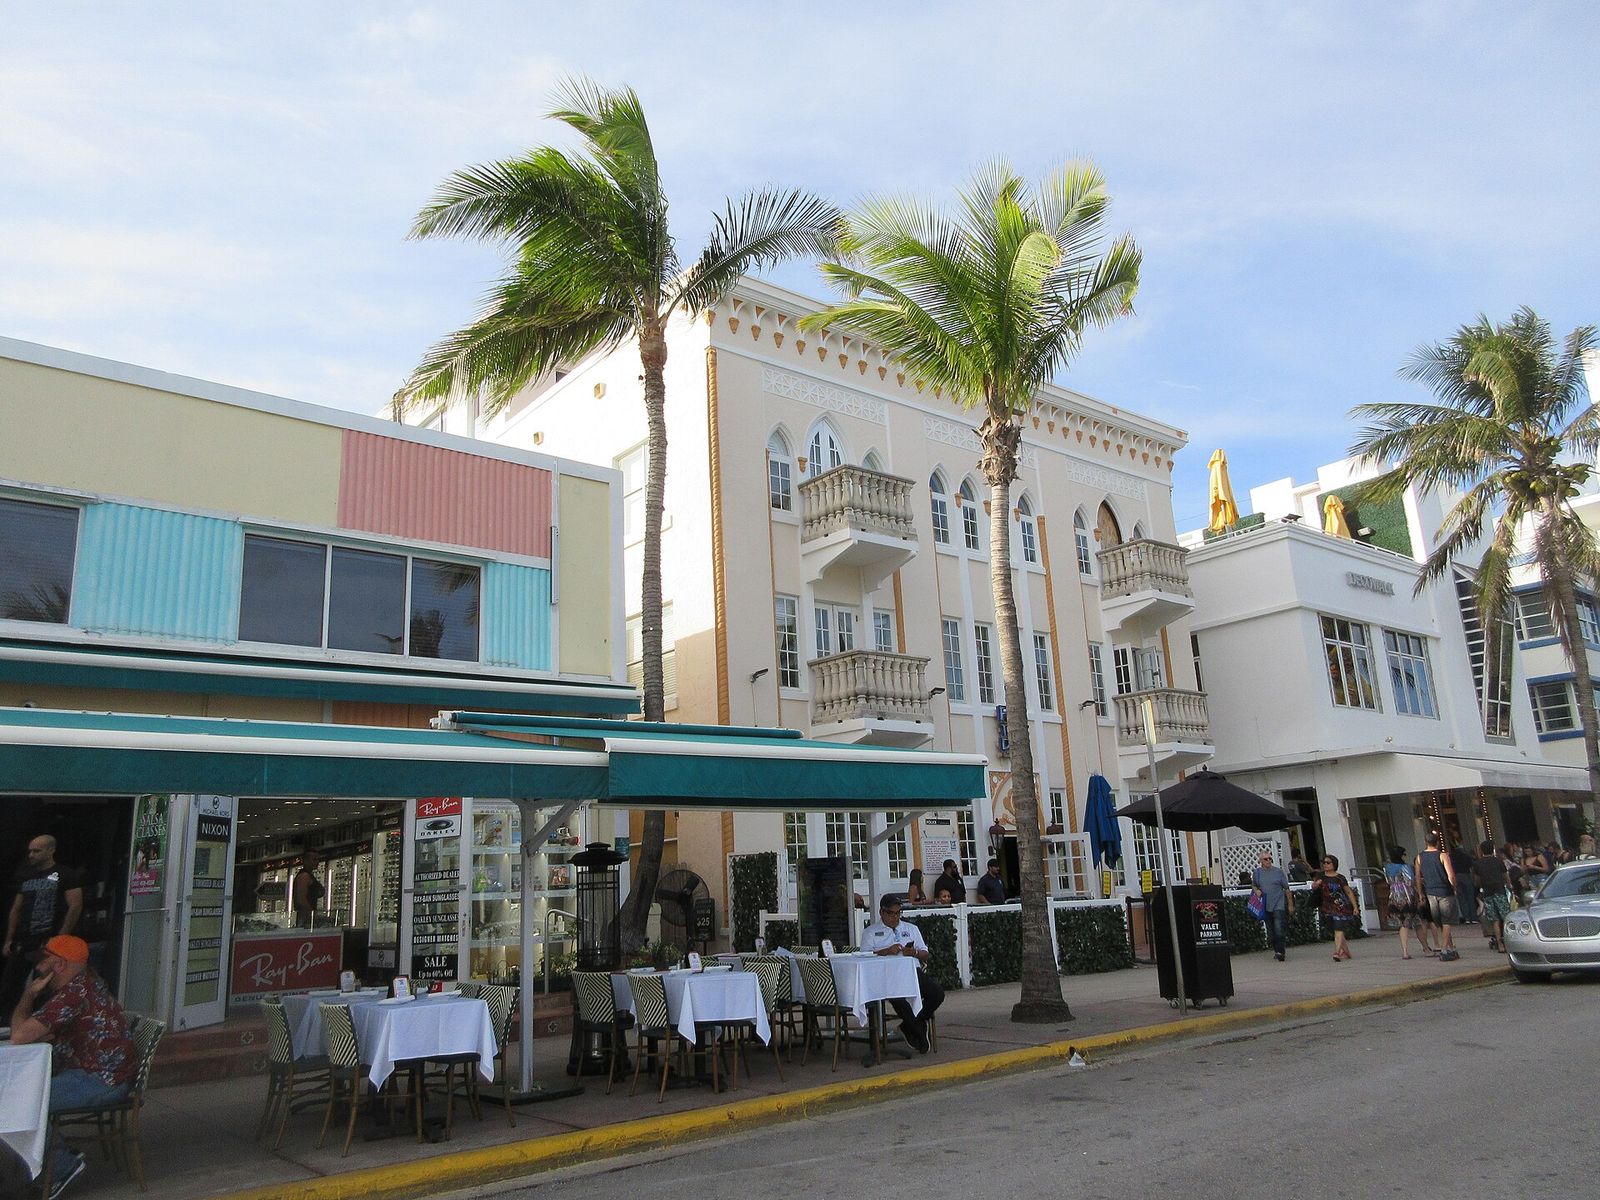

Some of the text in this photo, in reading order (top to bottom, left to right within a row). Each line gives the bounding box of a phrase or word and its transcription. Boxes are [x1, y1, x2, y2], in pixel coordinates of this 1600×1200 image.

[419, 797, 459, 815] Ray-Ban
[141, 813, 164, 826] SALSA
[136, 823, 167, 838] CLASSES
[201, 823, 230, 836] NIXON
[420, 828, 456, 837] OAKLEY
[415, 871, 442, 881] AUTHORIZED
[413, 895, 432, 903] RAY-BAN
[413, 916, 432, 924] OAKLEY
[413, 935, 436, 944] DESIGNER
[1200, 930, 1222, 938] PARKING
[239, 942, 334, 987] Ray-Ban
[424, 956, 448, 968] SALE
[418, 971, 426, 979] Up
[444, 968, 454, 977] Off
